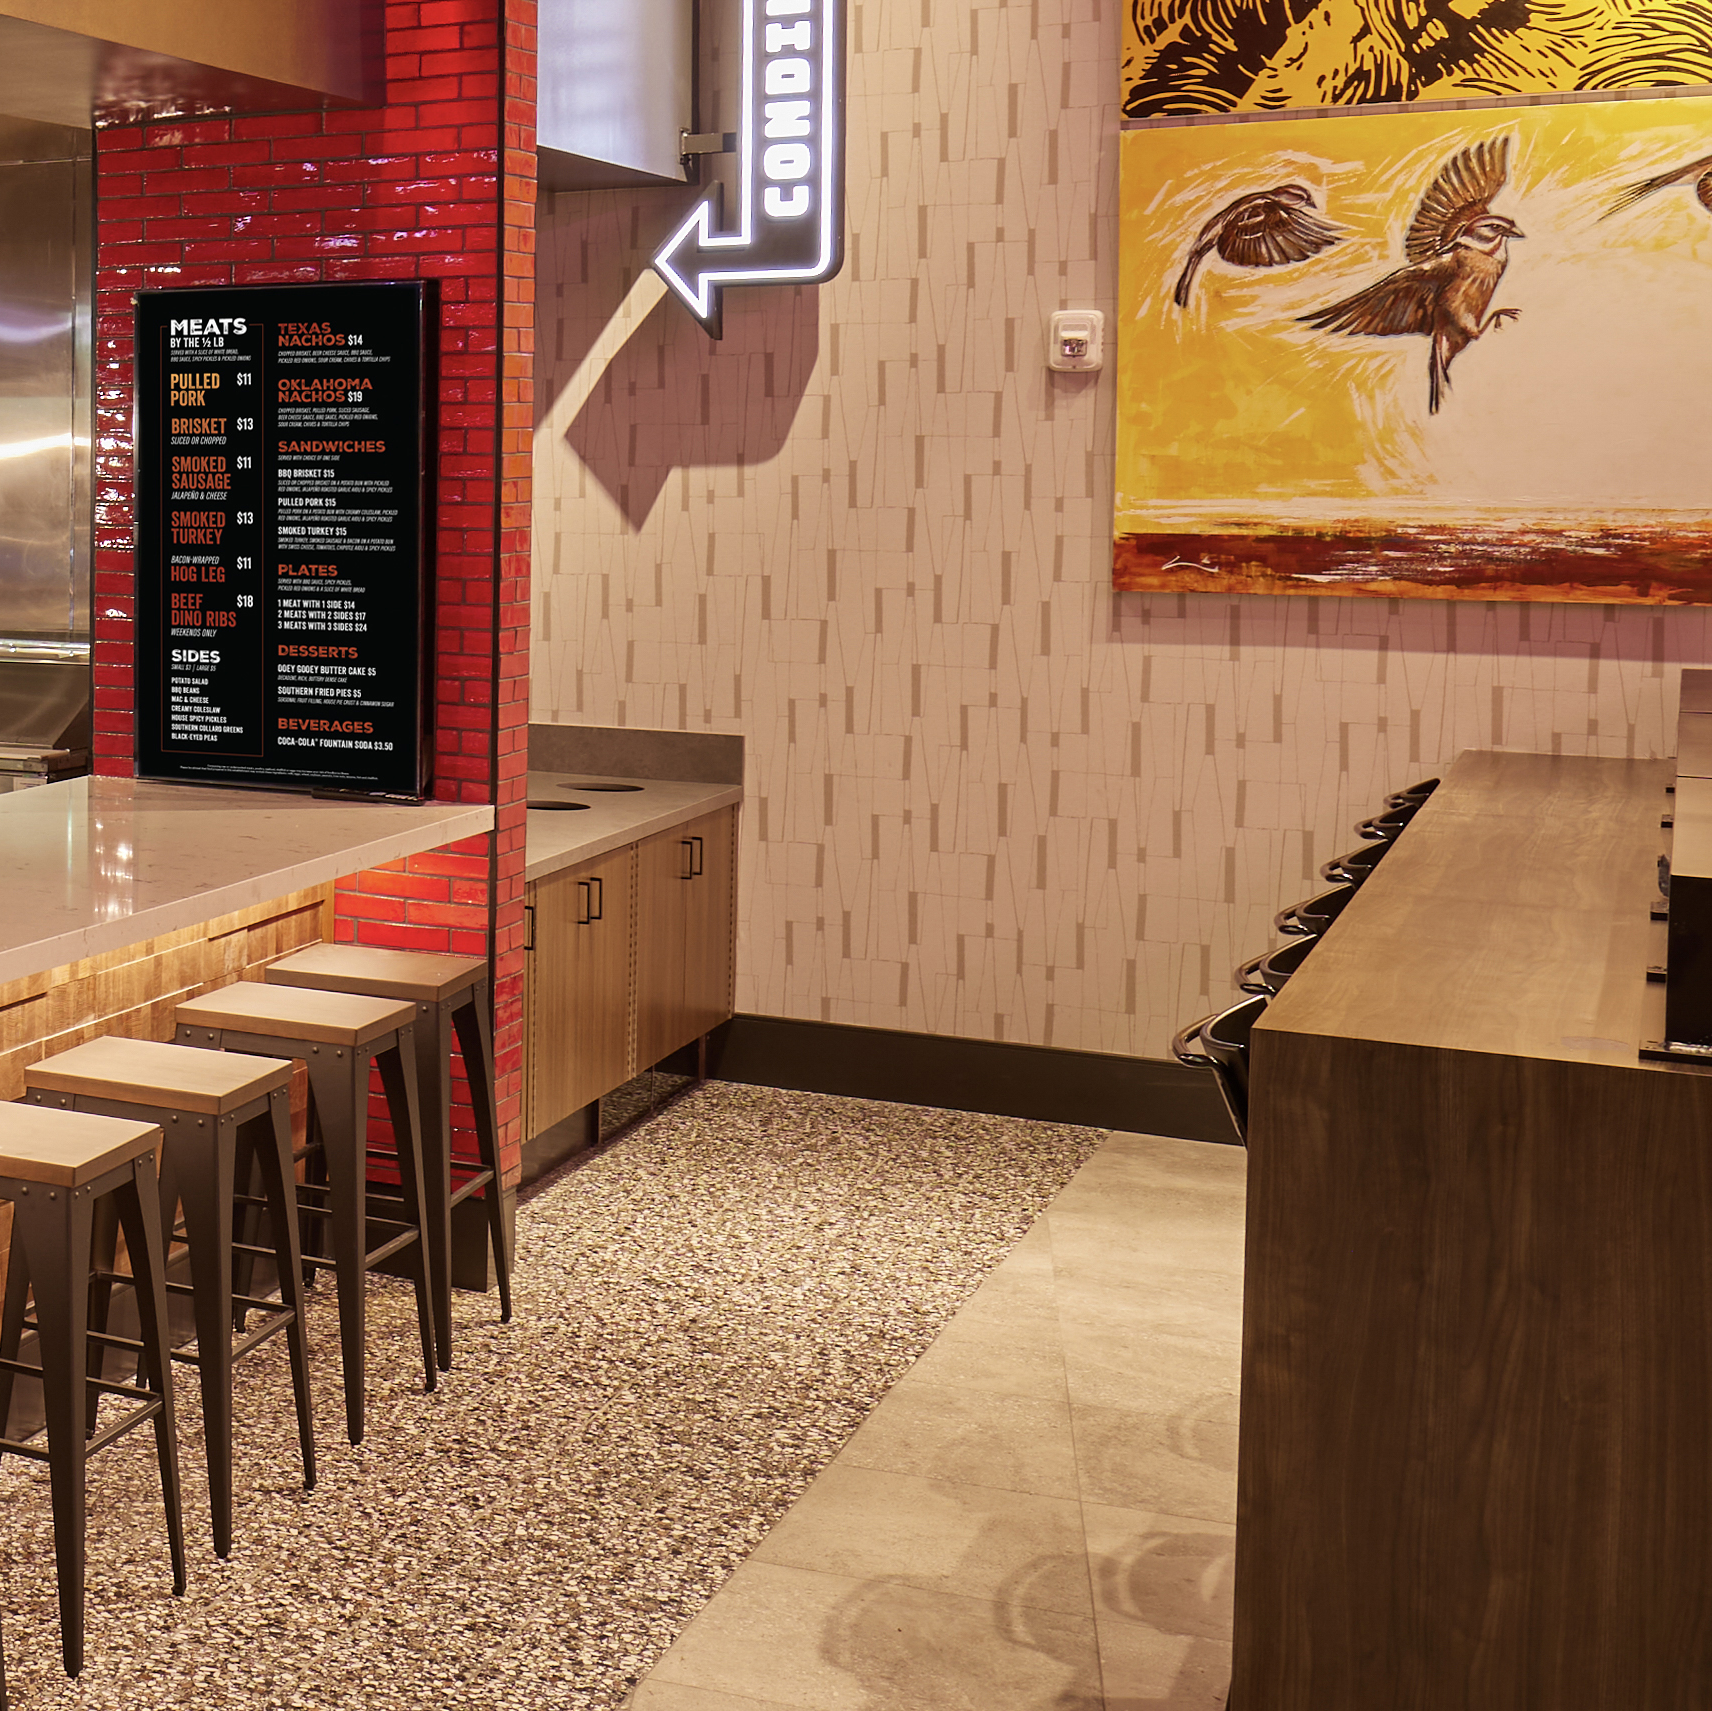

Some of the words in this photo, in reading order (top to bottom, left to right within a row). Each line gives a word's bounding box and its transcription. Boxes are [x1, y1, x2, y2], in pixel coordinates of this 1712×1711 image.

[170, 317, 247, 336] MEATS
[277, 321, 331, 336] TEXAS
[170, 337, 181, 348] BY
[183, 337, 200, 348] THE
[213, 336, 224, 347] LB
[278, 333, 345, 346] NACHOS
[347, 334, 363, 346] $14
[170, 372, 220, 389] PULLED
[236, 372, 251, 386] $11
[277, 378, 373, 392] OKLAHOMA
[170, 390, 205, 406] PORK
[278, 390, 345, 402] NACHOS
[347, 390, 362, 402] $19
[171, 417, 227, 434] BRISKET
[236, 417, 253, 431] $13
[170, 436, 190, 445] SLICED
[190, 436, 200, 445] OR
[199, 435, 227, 445] CHOPPED
[278, 440, 386, 452] SANDWICHES
[171, 456, 226, 472] SMOKED
[236, 455, 251, 469] $11
[277, 468, 292, 479] BBQ
[293, 468, 322, 478] BRISKET
[323, 468, 335, 478] $15
[171, 473, 231, 489] SAUSAGE
[170, 490, 199, 500] JALAPEÑO
[199, 491, 205, 500] &
[205, 491, 227, 500] CHEESE
[277, 497, 304, 506] PULLED
[304, 497, 323, 506] PORK
[324, 497, 336, 507] $15
[171, 510, 225, 527] SMOKED
[236, 511, 253, 525] $13
[170, 528, 222, 544] TURKEY
[277, 526, 306, 535] SMOKED
[307, 526, 334, 535] TURKEY
[335, 526, 347, 536] $15
[170, 555, 220, 564] BACON-WRAPPED
[236, 556, 251, 570] $11
[170, 565, 197, 582] HOG
[201, 566, 225, 582] LEG
[278, 564, 338, 577] PLATES
[171, 593, 203, 609] BEEF
[236, 594, 253, 608] $18
[277, 599, 281, 607] 1
[282, 598, 301, 608] MEAT
[302, 599, 320, 608] WITH
[321, 600, 325, 608] 1
[326, 599, 342, 609] SIDE
[343, 600, 355, 609] $14
[171, 609, 202, 626] DINO
[206, 610, 236, 627] RIBS
[277, 609, 282, 618] 2
[283, 609, 307, 619] MEATS
[307, 610, 326, 619] WITH
[327, 610, 332, 620] 2
[333, 611, 353, 620] SIDES
[354, 611, 366, 621] $17
[170, 627, 201, 637] WEEKENDS
[201, 628, 217, 637] ONLY
[277, 620, 282, 629] 3
[283, 620, 307, 630] MEATS
[307, 621, 326, 630] WITH
[327, 621, 332, 631] 3
[332, 622, 353, 631] SIDES
[354, 622, 367, 632] $24
[171, 648, 220, 663] SIDES
[278, 644, 358, 659] DESSERTS
[277, 663, 295, 673] OOEY
[296, 664, 319, 674] GOOEY
[320, 665, 347, 675] BUTTER
[348, 666, 366, 676] CAKE
[367, 667, 376, 676] $5
[171, 676, 191, 684] POTATO
[191, 677, 209, 685] SALAD
[171, 686, 182, 694] BBQ
[182, 686, 200, 694] BEANS
[277, 685, 313, 696] SOUTHERN
[314, 687, 335, 697] FRIED
[335, 688, 352, 697] PIES
[352, 689, 361, 698] $5
[189, 696, 209, 704] CHEESE
[171, 704, 192, 712] CREAMY
[193, 705, 221, 713] COLESLAW
[189, 714, 204, 722] SPICY
[204, 715, 227, 723] PICKLES
[278, 717, 373, 733] BEVERAGES
[171, 723, 198, 731] SOUTHERN
[198, 724, 222, 732] COLLARD
[222, 725, 243, 734] GREENS
[171, 732, 203, 741] BLACK-EYED
[319, 738, 353, 748] FOUNTAIN
[354, 740, 373, 749] SODA
[373, 741, 393, 751] $3.50
